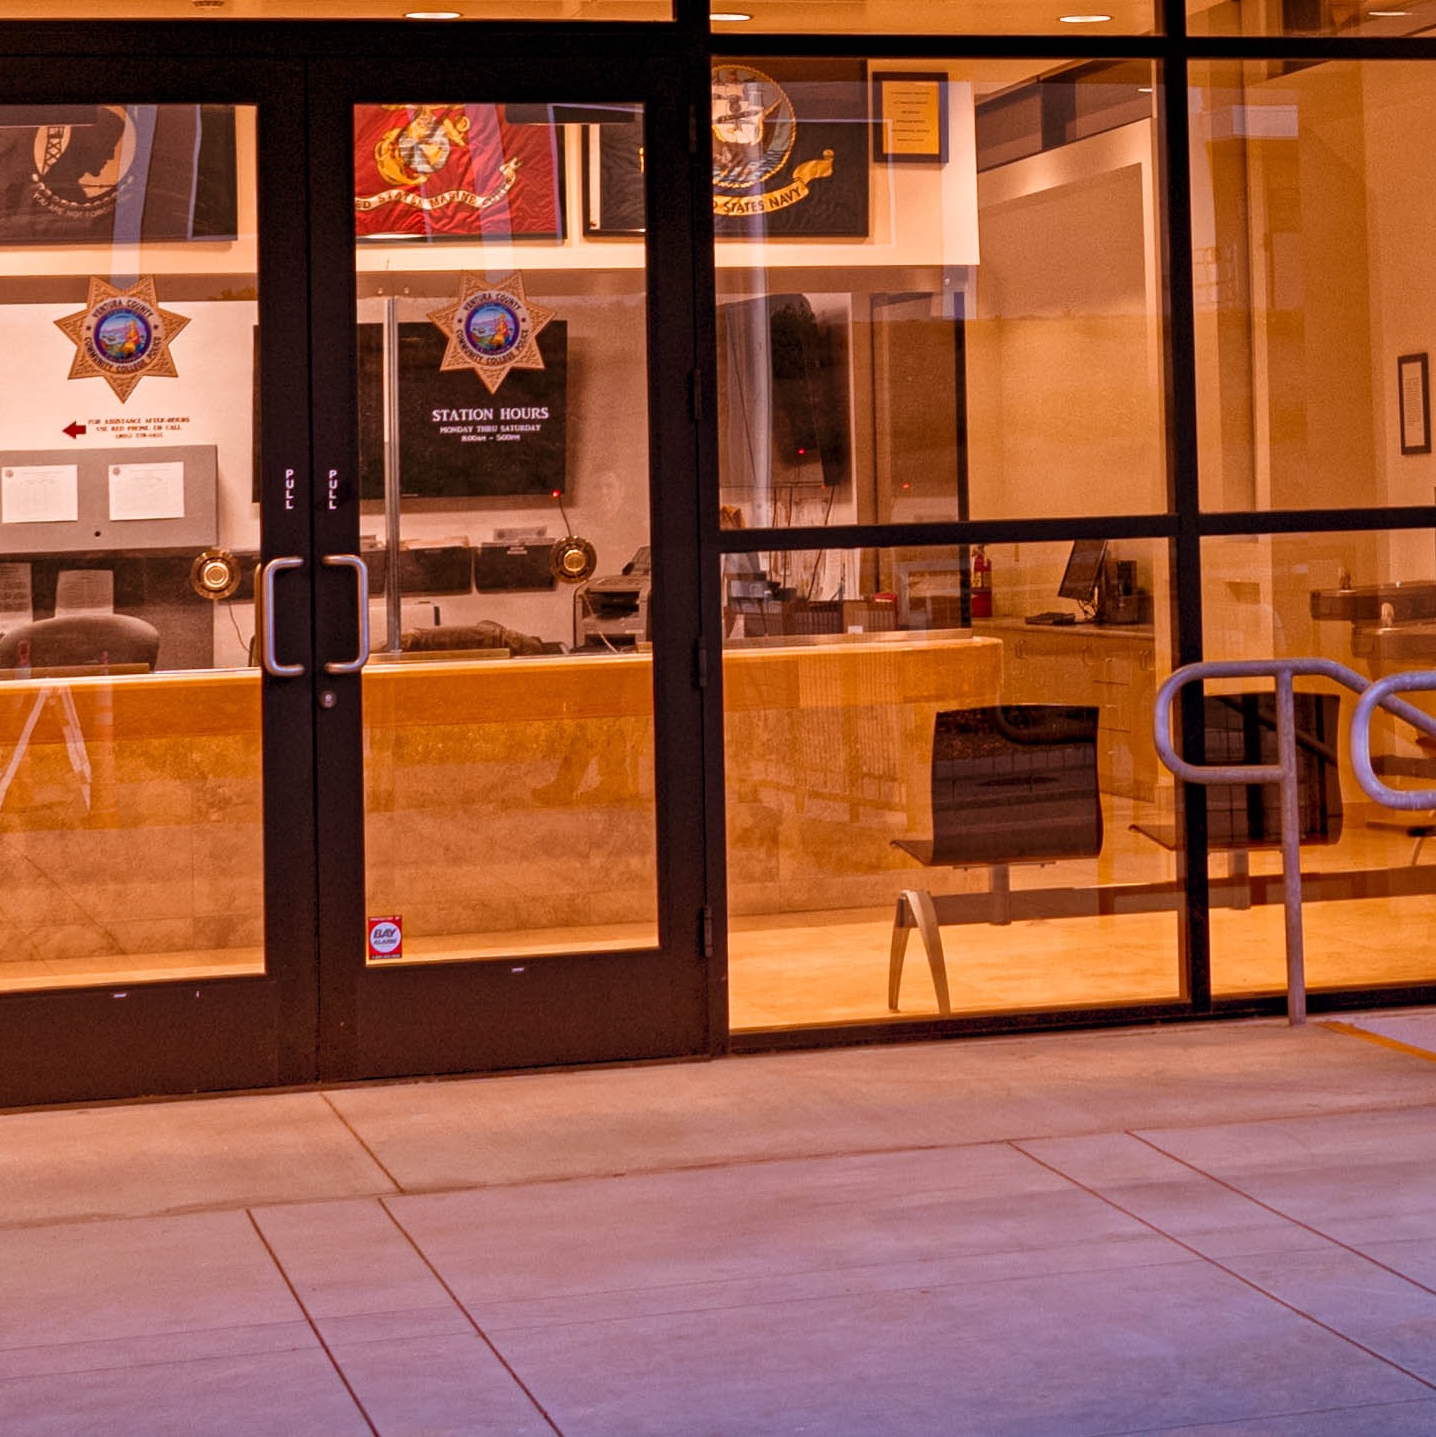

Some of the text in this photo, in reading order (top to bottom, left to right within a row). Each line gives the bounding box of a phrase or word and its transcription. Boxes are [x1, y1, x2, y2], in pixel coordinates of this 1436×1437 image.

[724, 187, 801, 213] STATES NAVY
[92, 299, 154, 318] VENTURA COUNTY
[464, 293, 521, 311] VENTURA COUNTY
[432, 407, 549, 421] STATION HOURS
[476, 425, 498, 433] THRU
[286, 469, 294, 510] PULL
[329, 469, 338, 510] PULL
[374, 928, 397, 939] BAY
